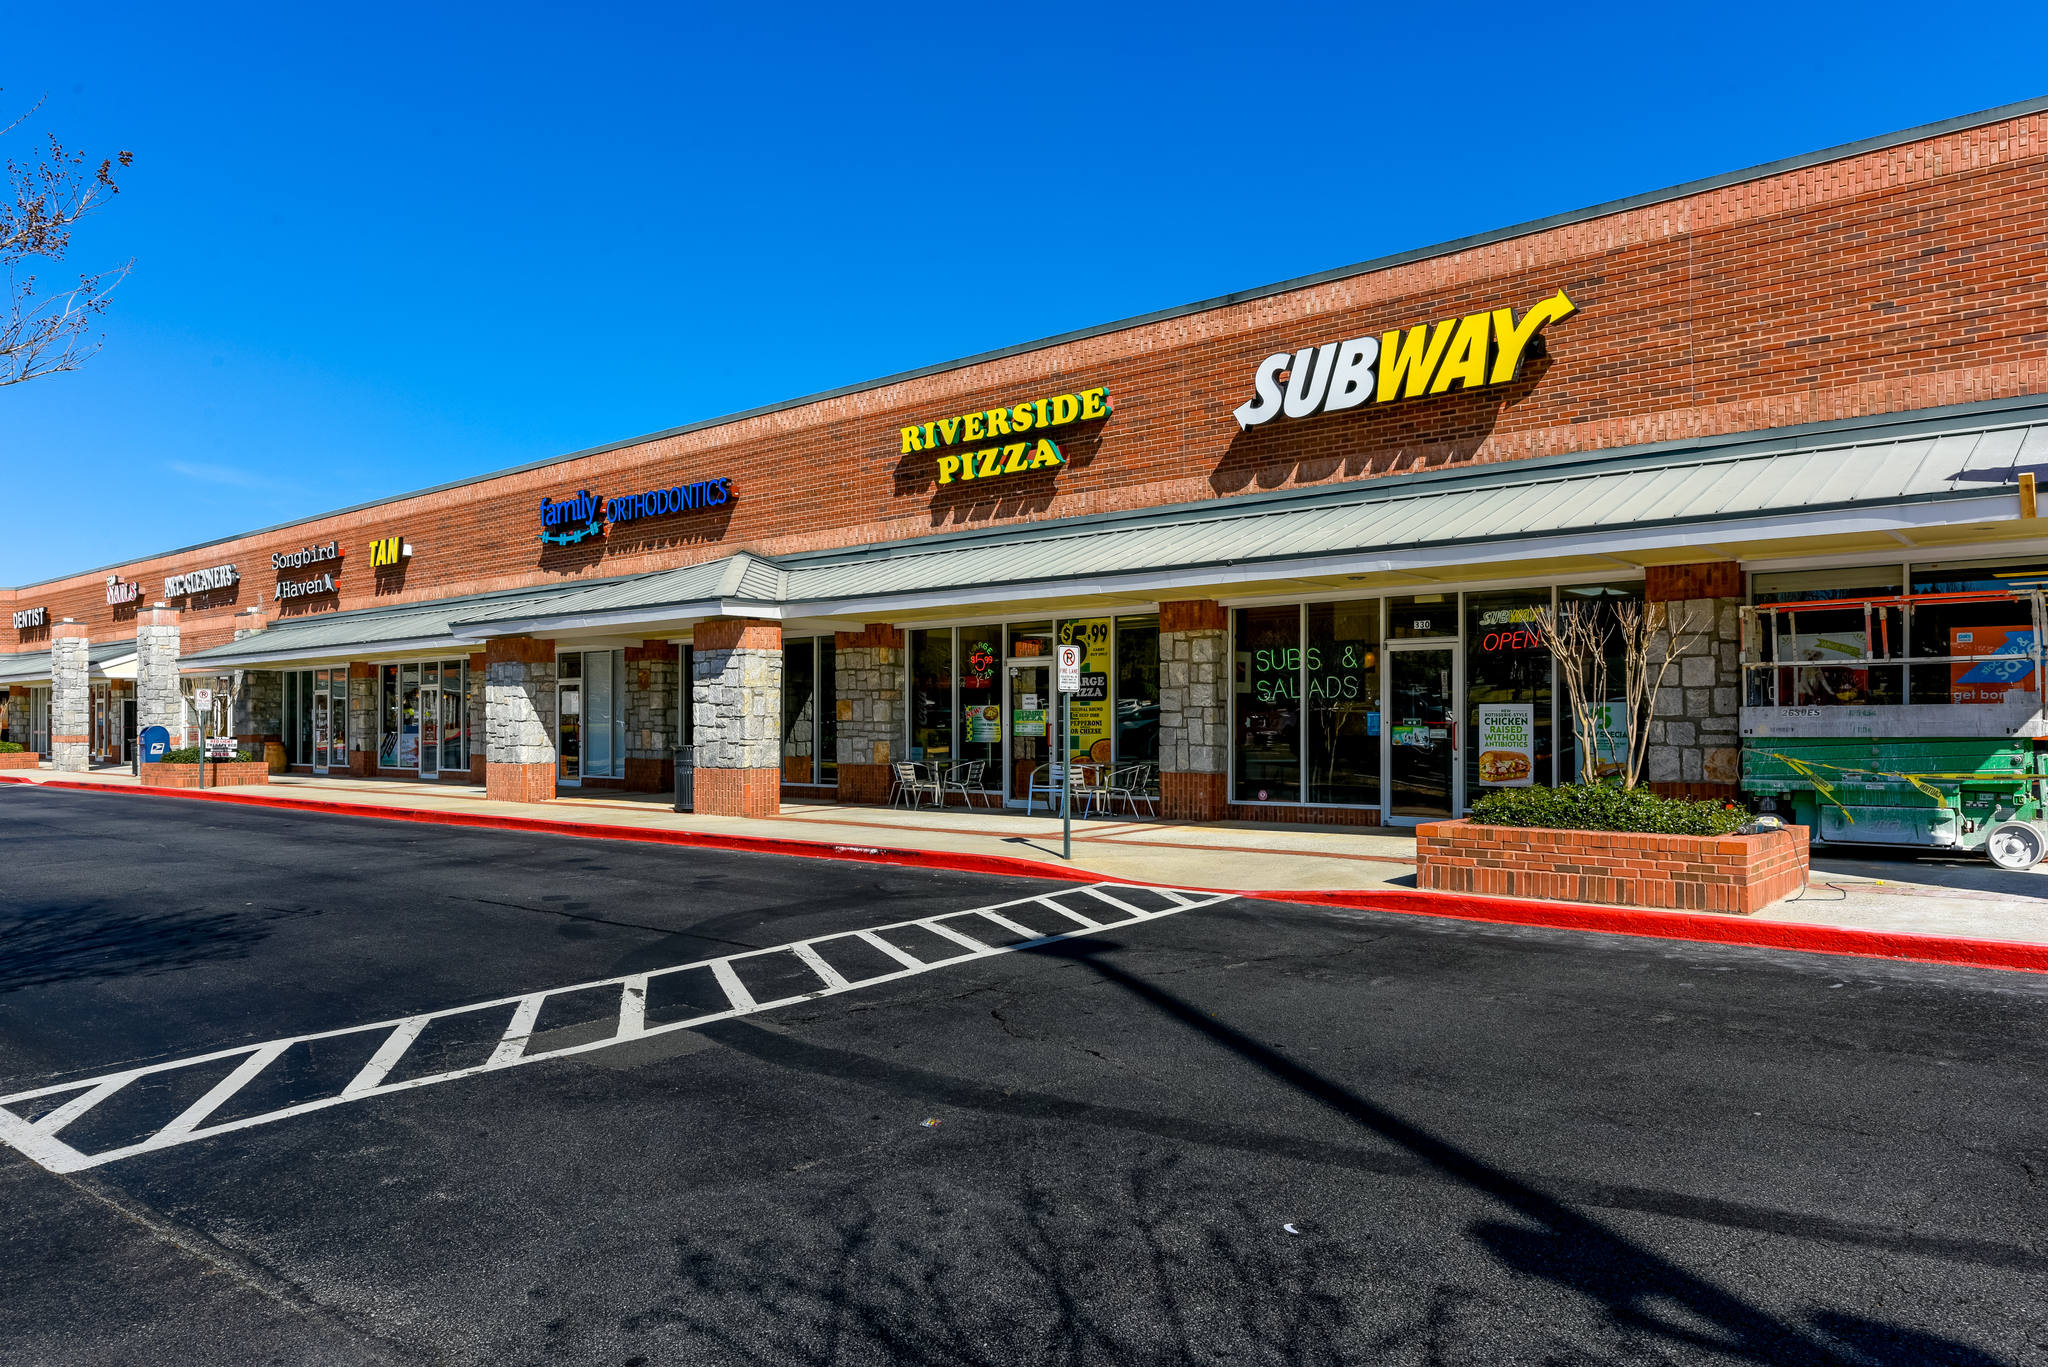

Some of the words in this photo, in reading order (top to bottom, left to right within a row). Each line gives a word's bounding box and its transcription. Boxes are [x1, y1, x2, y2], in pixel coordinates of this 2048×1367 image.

[1232, 288, 1579, 431] SUBWAY
[900, 386, 1110, 454] RIVERSIDE
[937, 439, 1064, 485] PIZZA
[540, 489, 601, 527] family
[606, 477, 729, 523] ORTHODONTICS
[271, 541, 336, 570] Songbird
[369, 537, 401, 567] TAN
[184, 564, 234, 595] CLEANERS
[281, 579, 323, 599] Haven
[12, 606, 46, 630] DENTIST
[1415, 620, 1430, 630] 330
[1483, 629, 1542, 651] OPEN
[1256, 647, 1321, 671] SUBS
[1342, 646, 1358, 668] &
[1080, 676, 1105, 687] RGE
[1256, 675, 1358, 701] SALADS
[1953, 690, 1976, 704] get
[1484, 717, 1528, 725] CHICKEN
